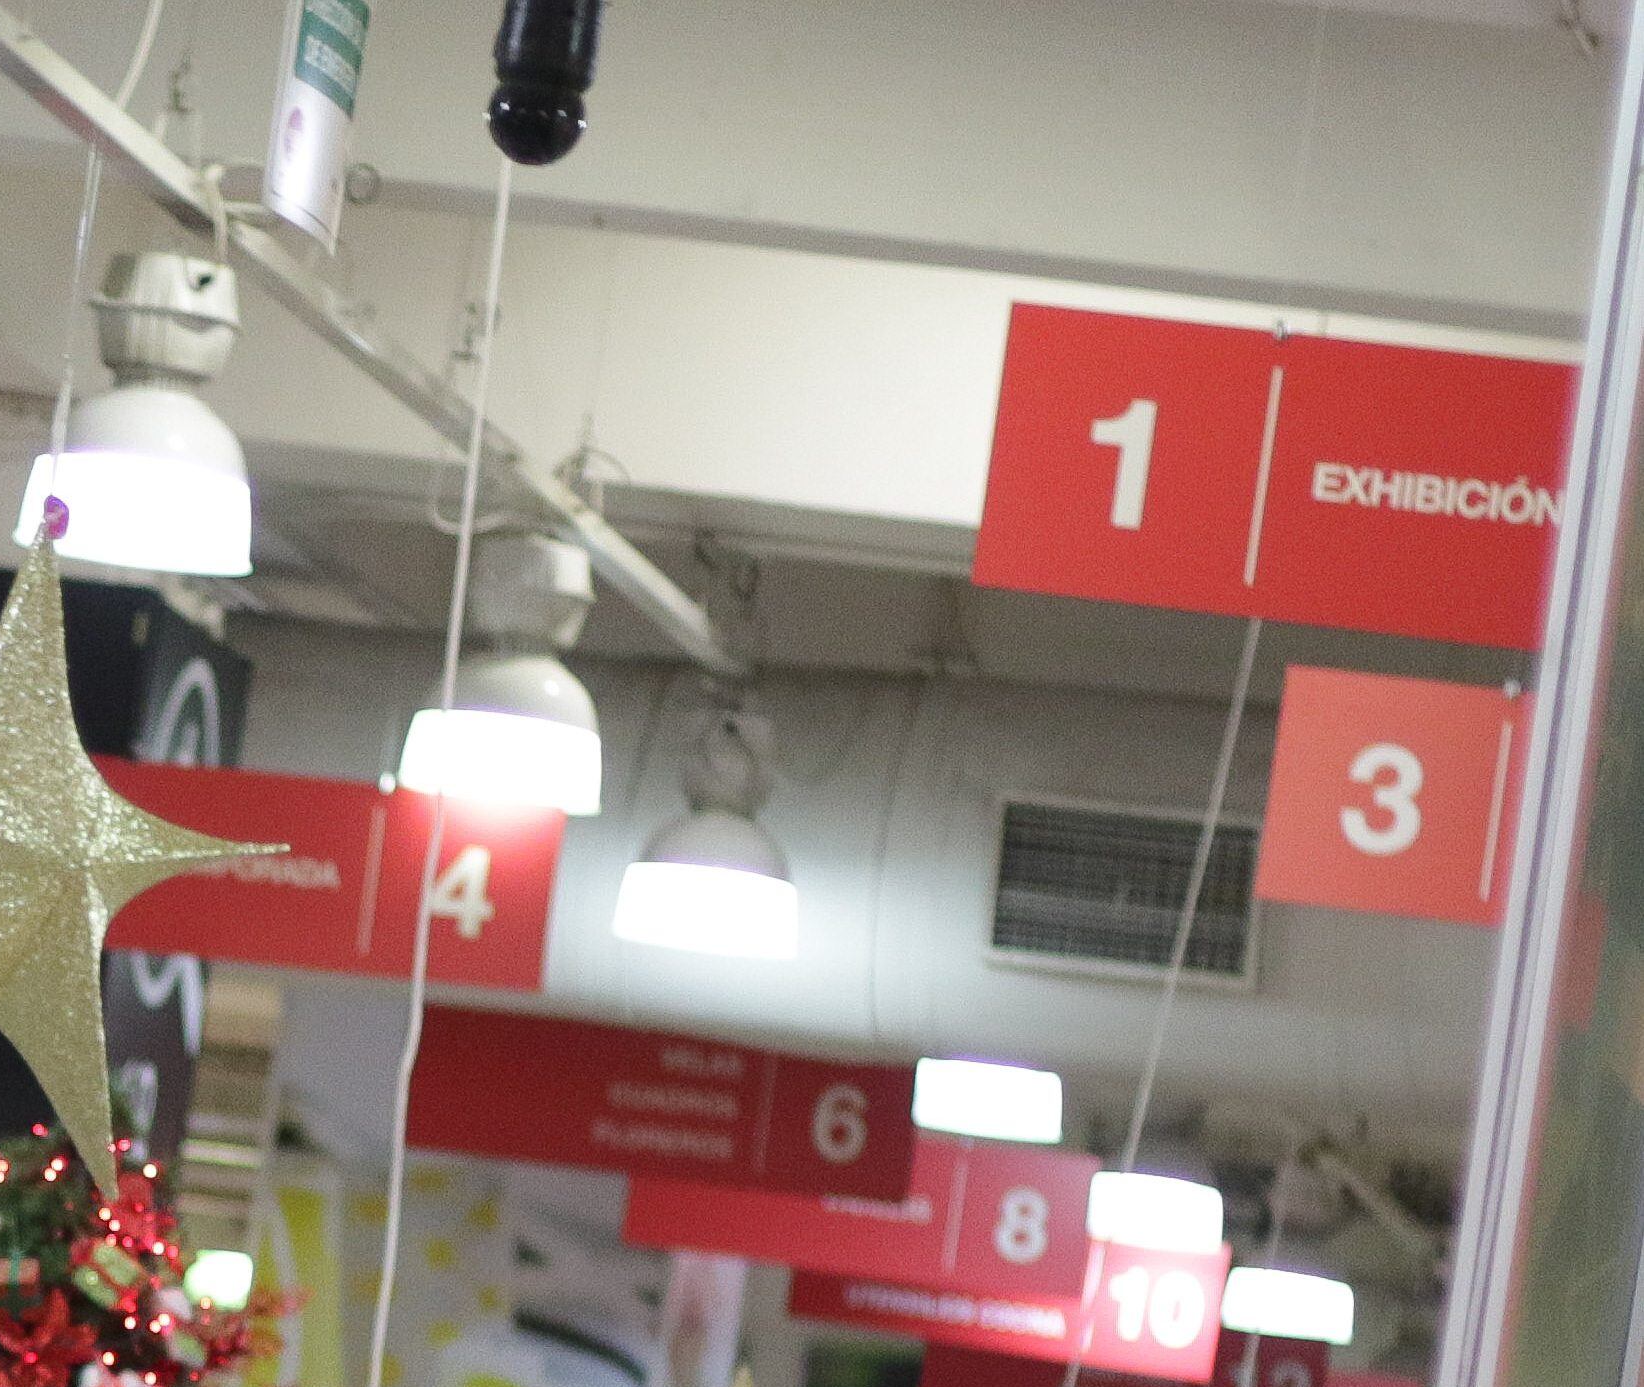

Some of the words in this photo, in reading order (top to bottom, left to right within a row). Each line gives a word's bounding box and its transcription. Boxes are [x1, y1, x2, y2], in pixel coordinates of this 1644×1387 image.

[1090, 398, 1158, 531] 1
[1311, 460, 1565, 528] EXHIBICIÓN
[1339, 742, 1424, 856] 3
[429, 845, 496, 940] 4
[812, 1082, 869, 1164] 6
[993, 1186, 1050, 1265] 8
[1108, 1267, 1207, 1350] 10
